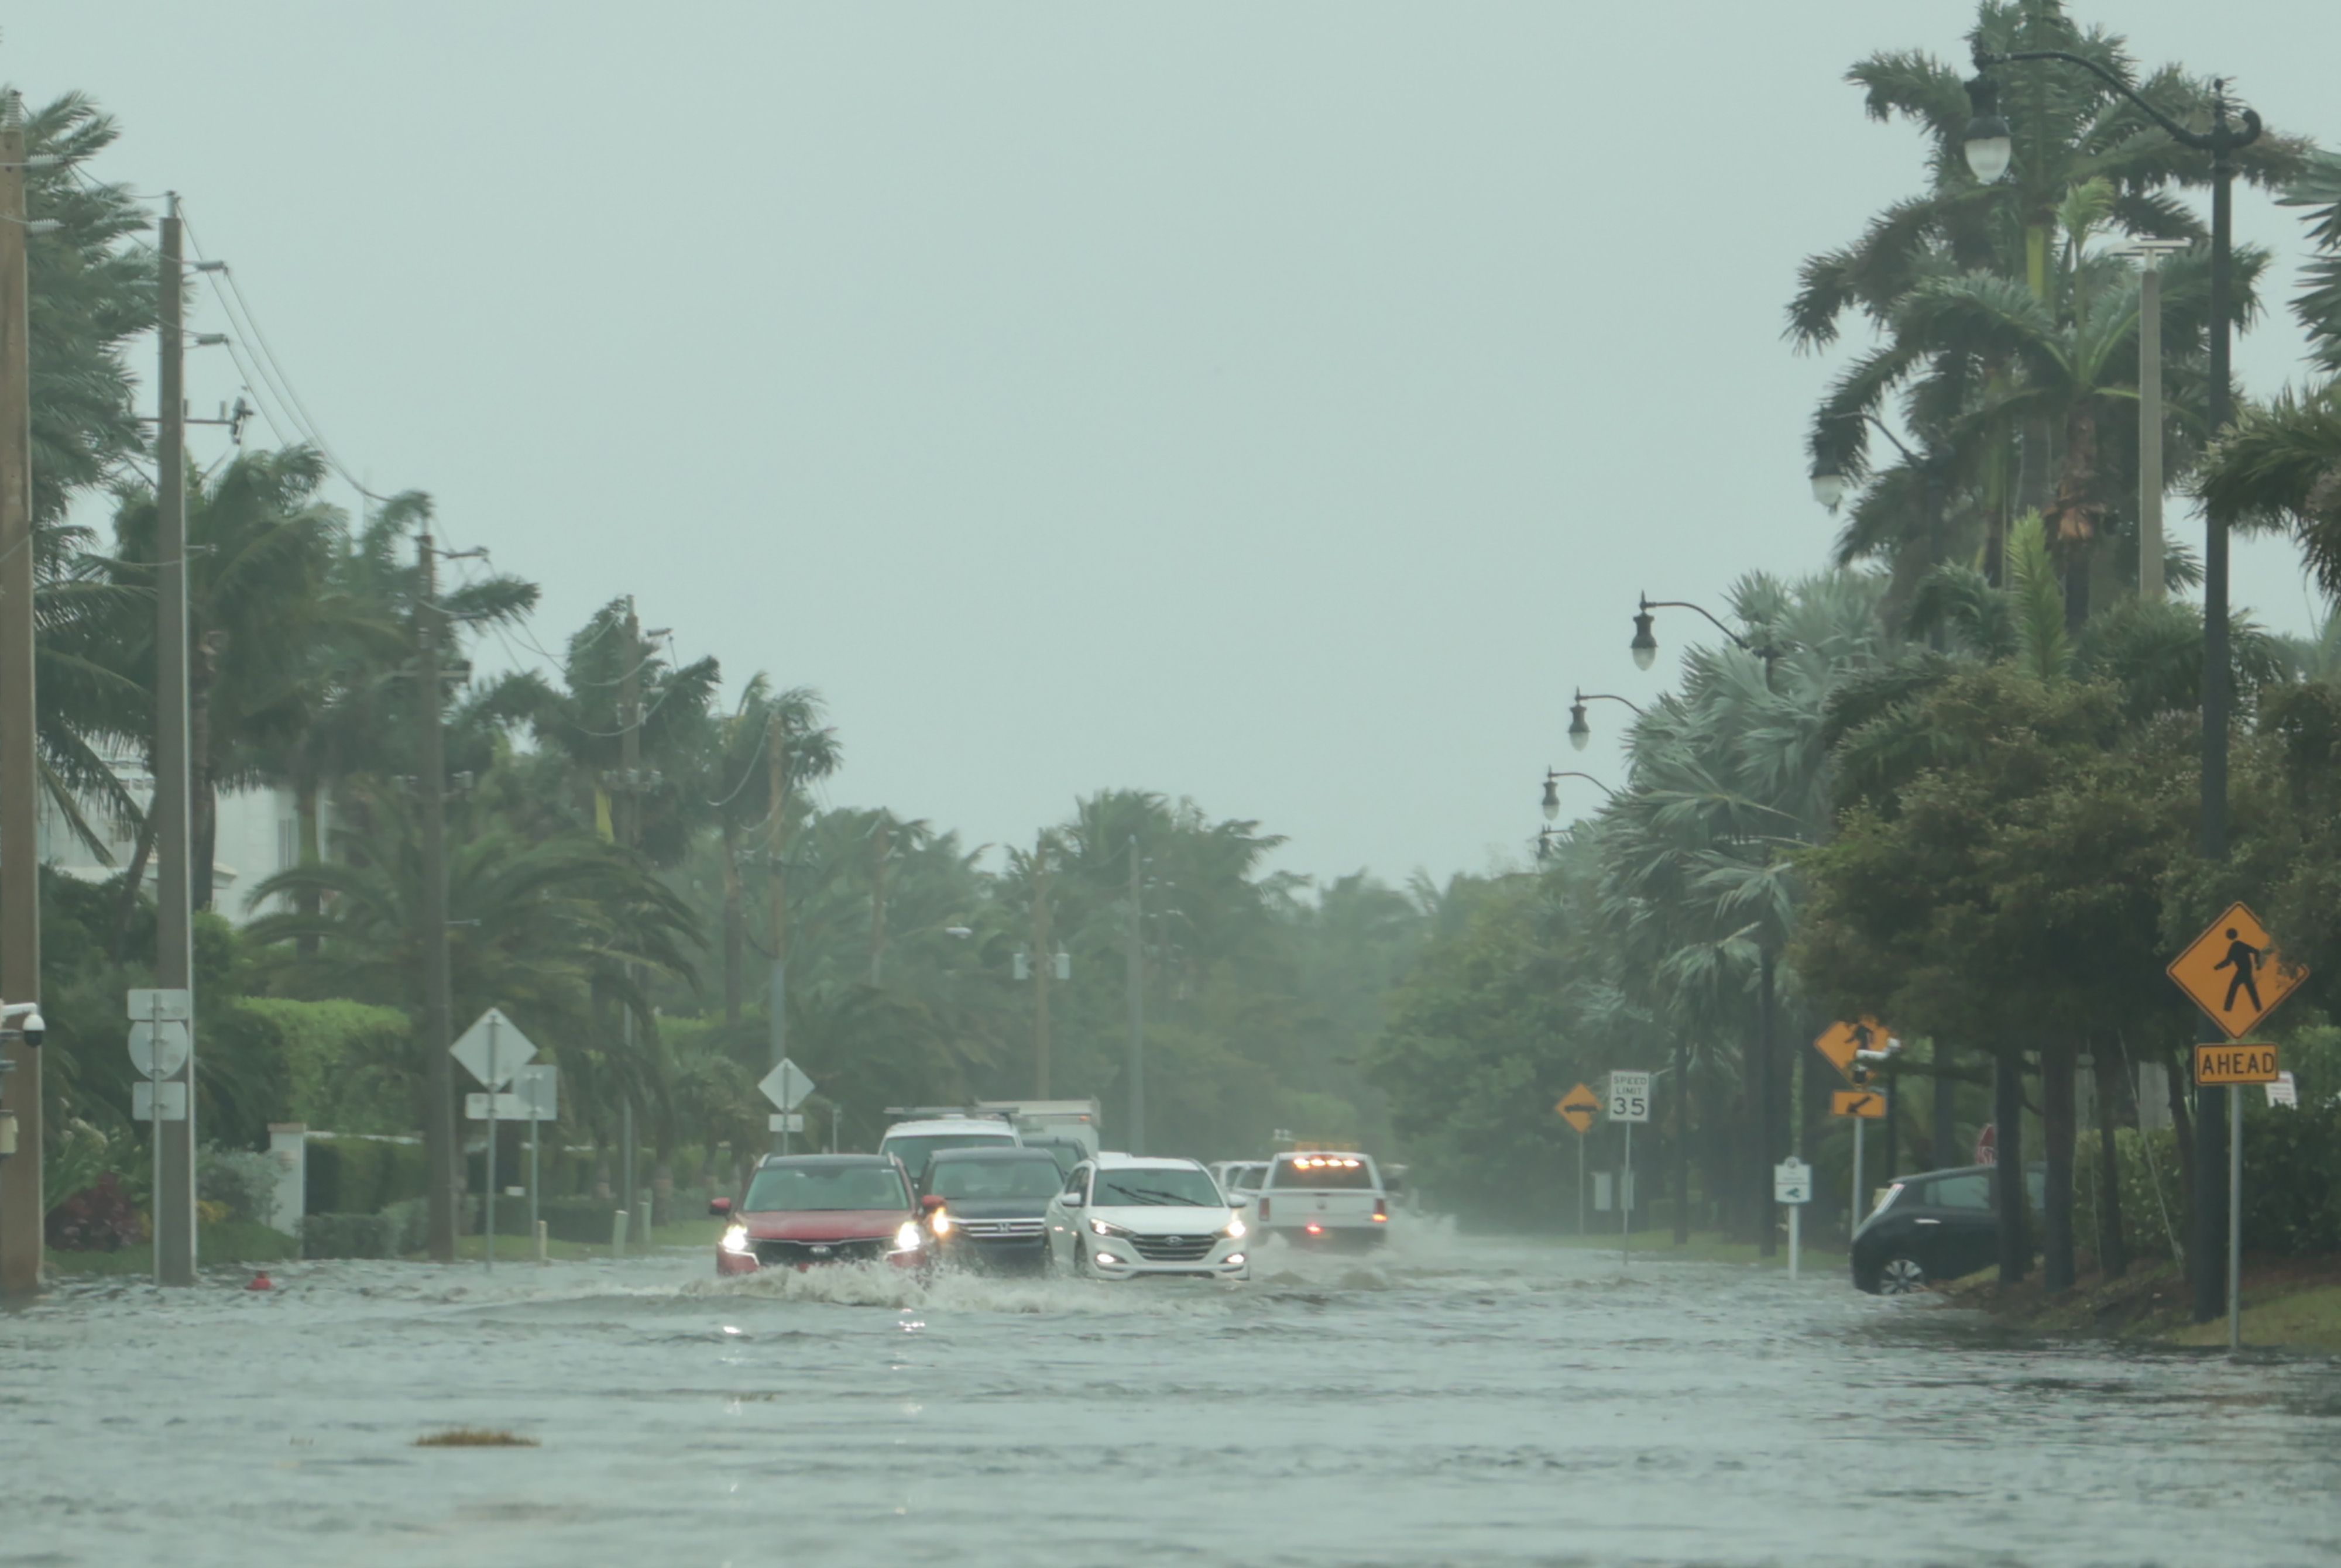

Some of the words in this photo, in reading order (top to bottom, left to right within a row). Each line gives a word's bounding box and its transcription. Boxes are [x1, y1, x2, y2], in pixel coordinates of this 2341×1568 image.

[2202, 1053, 2274, 1075] AHEAD
[1614, 1076, 1647, 1085] SPEED
[1613, 1097, 1645, 1116] 35
